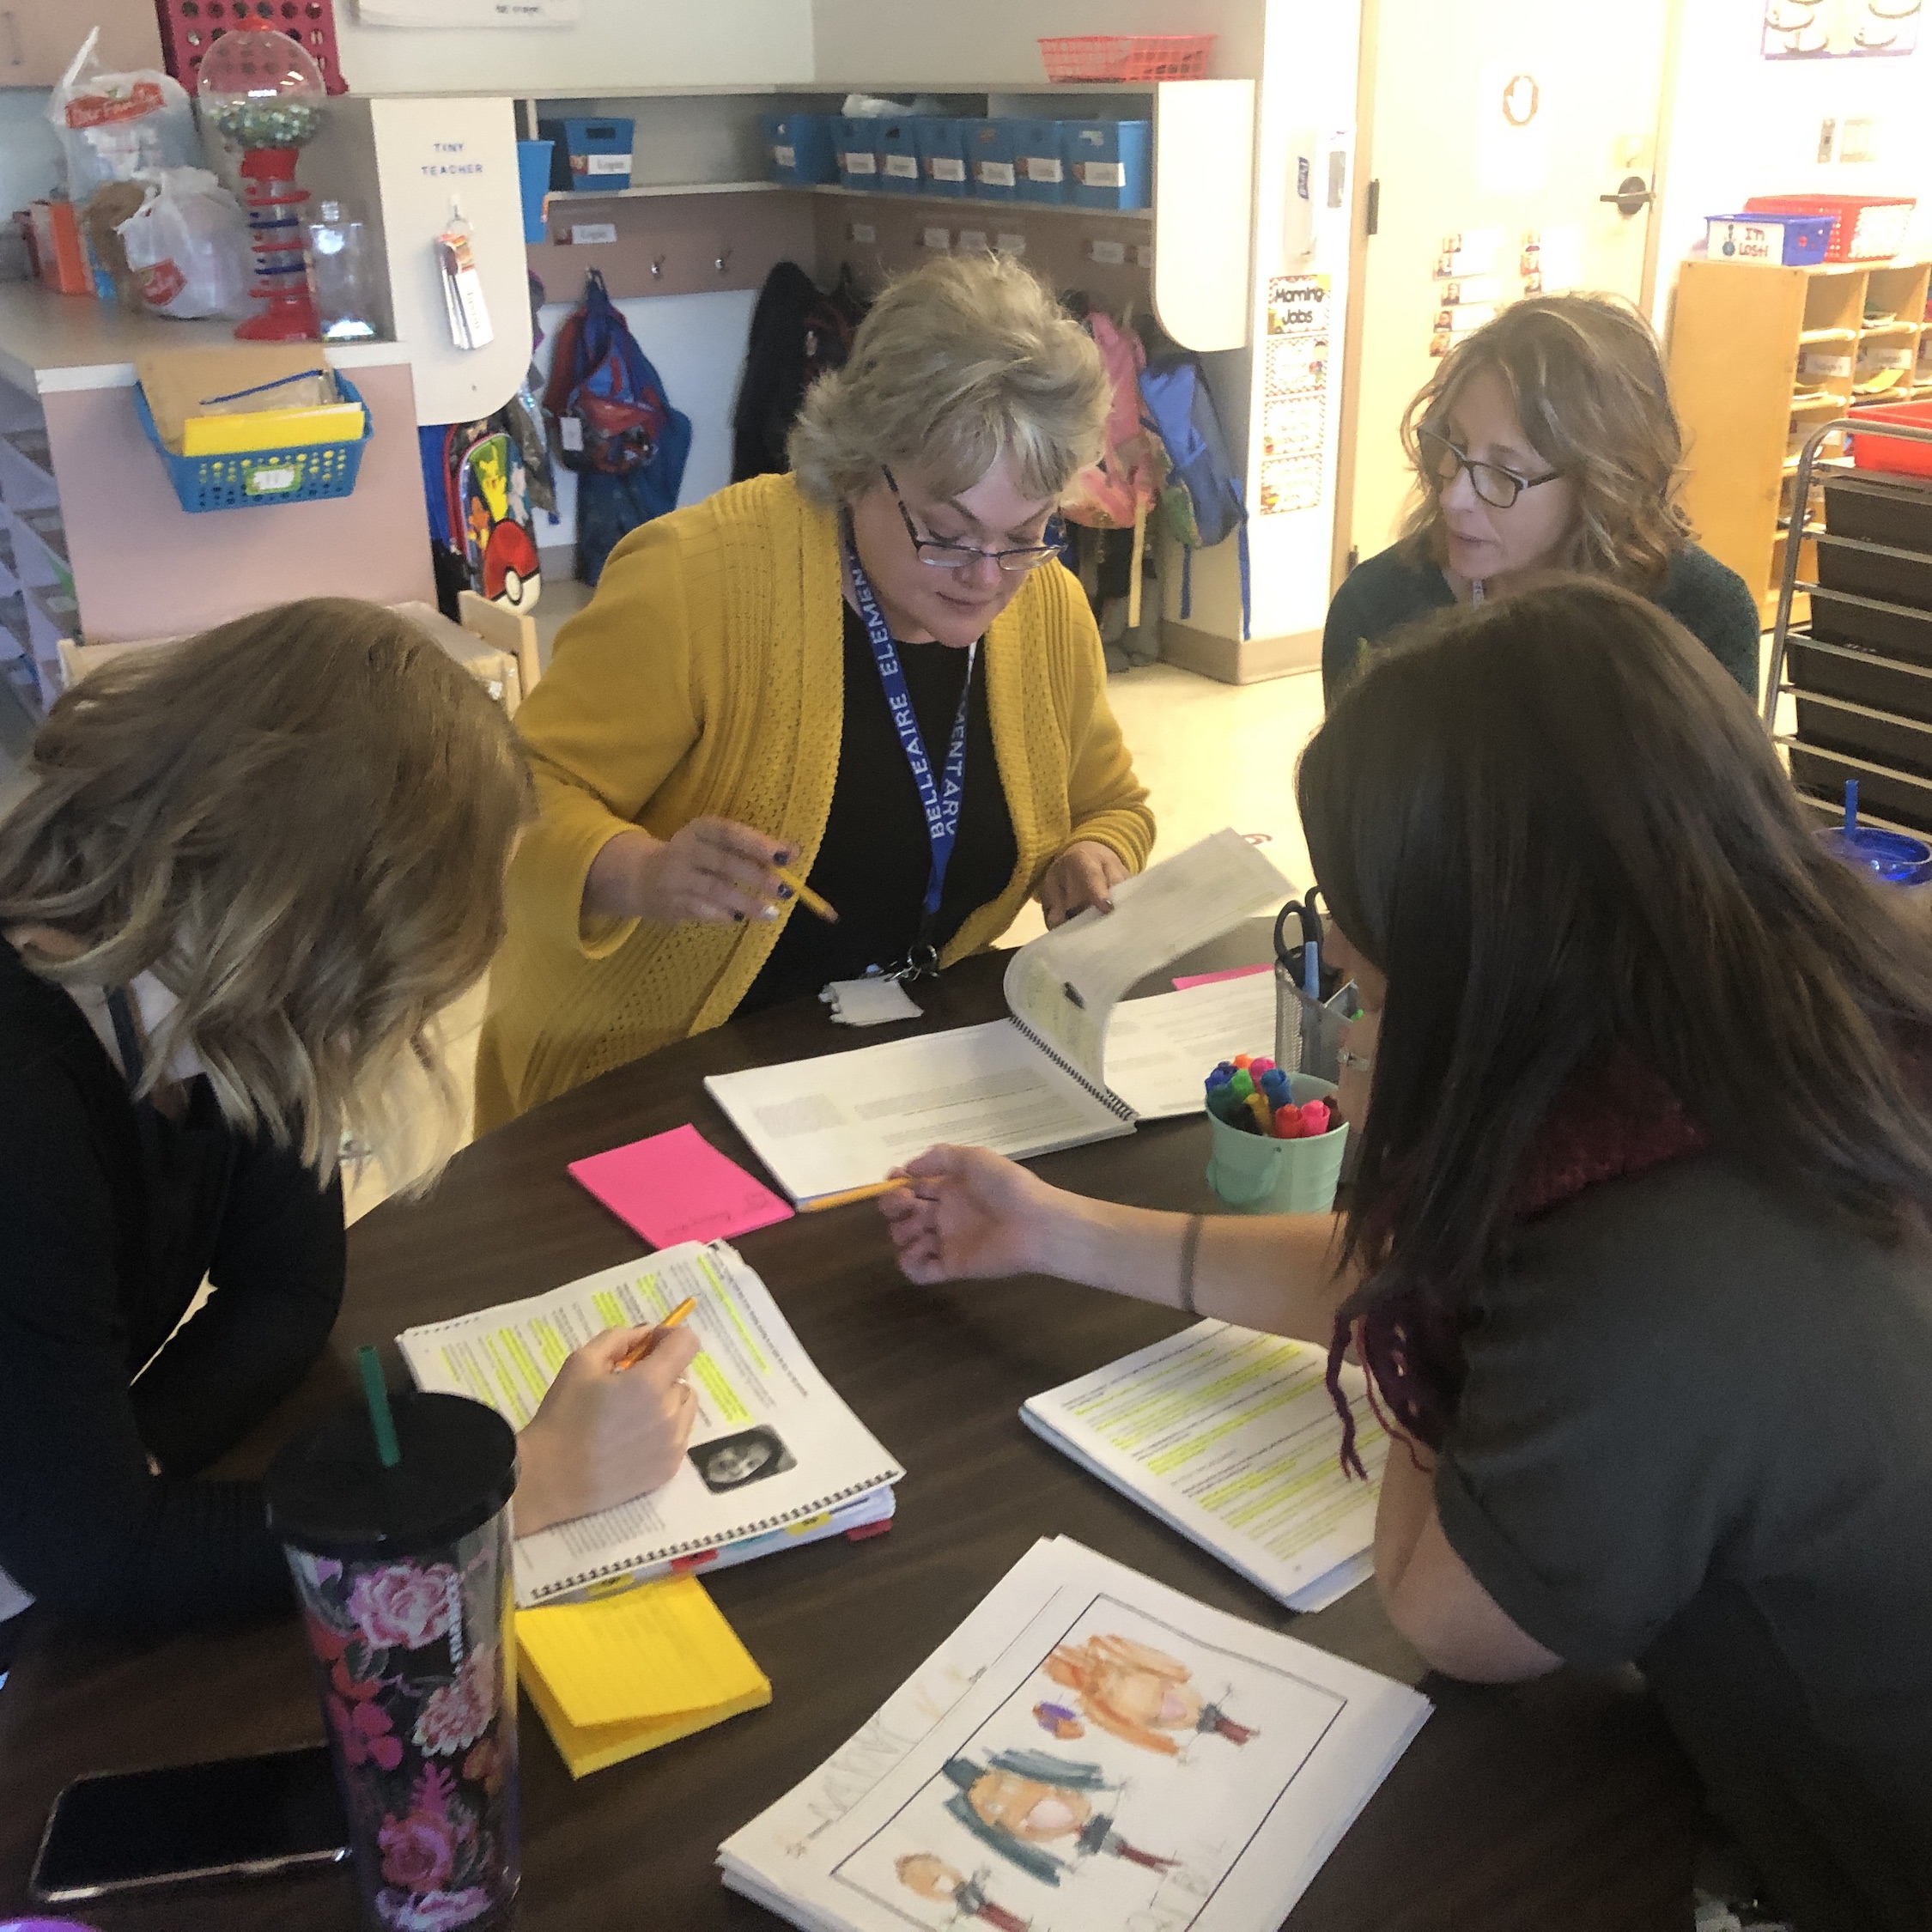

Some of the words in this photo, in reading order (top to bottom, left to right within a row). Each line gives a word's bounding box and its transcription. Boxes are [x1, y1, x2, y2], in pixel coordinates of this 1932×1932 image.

[433, 143, 464, 152] TINY
[421, 164, 483, 176] TEACHER
[1275, 287, 1325, 303] Morning
[1281, 308, 1313, 325] Jobs
[850, 556, 899, 677] ELEMEN
[889, 692, 945, 839] BELLEAIRE
